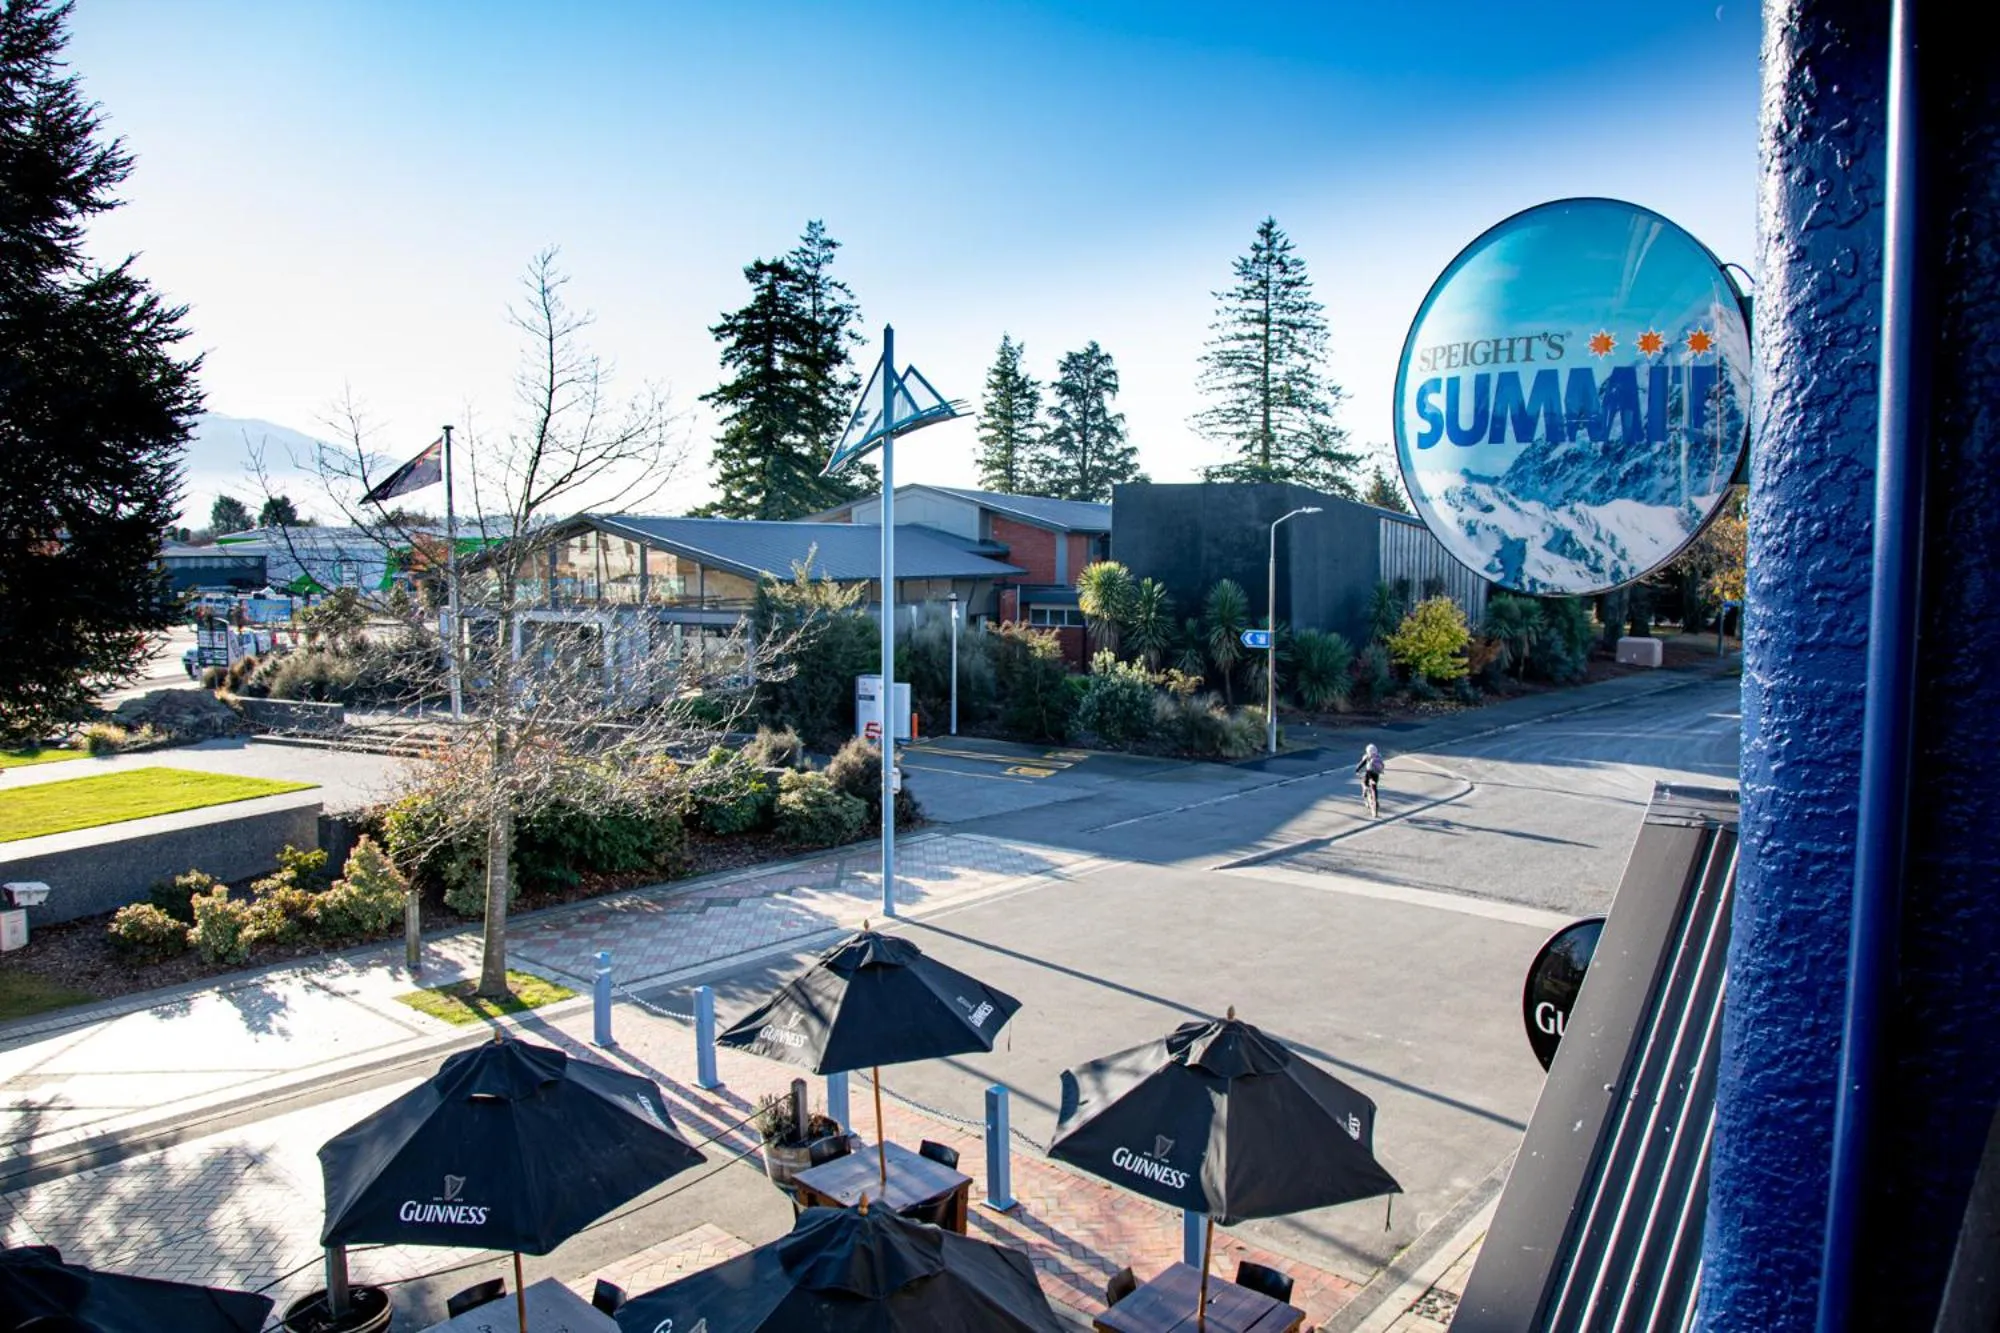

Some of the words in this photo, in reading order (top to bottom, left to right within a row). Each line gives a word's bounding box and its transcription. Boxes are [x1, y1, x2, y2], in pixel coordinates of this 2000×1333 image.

[1419, 331, 1565, 373] SPEIGHT'S
[1415, 366, 1718, 450] SUMMIT
[1112, 1147, 1187, 1189] GUINNESS
[399, 1200, 487, 1225] GUINNESS
